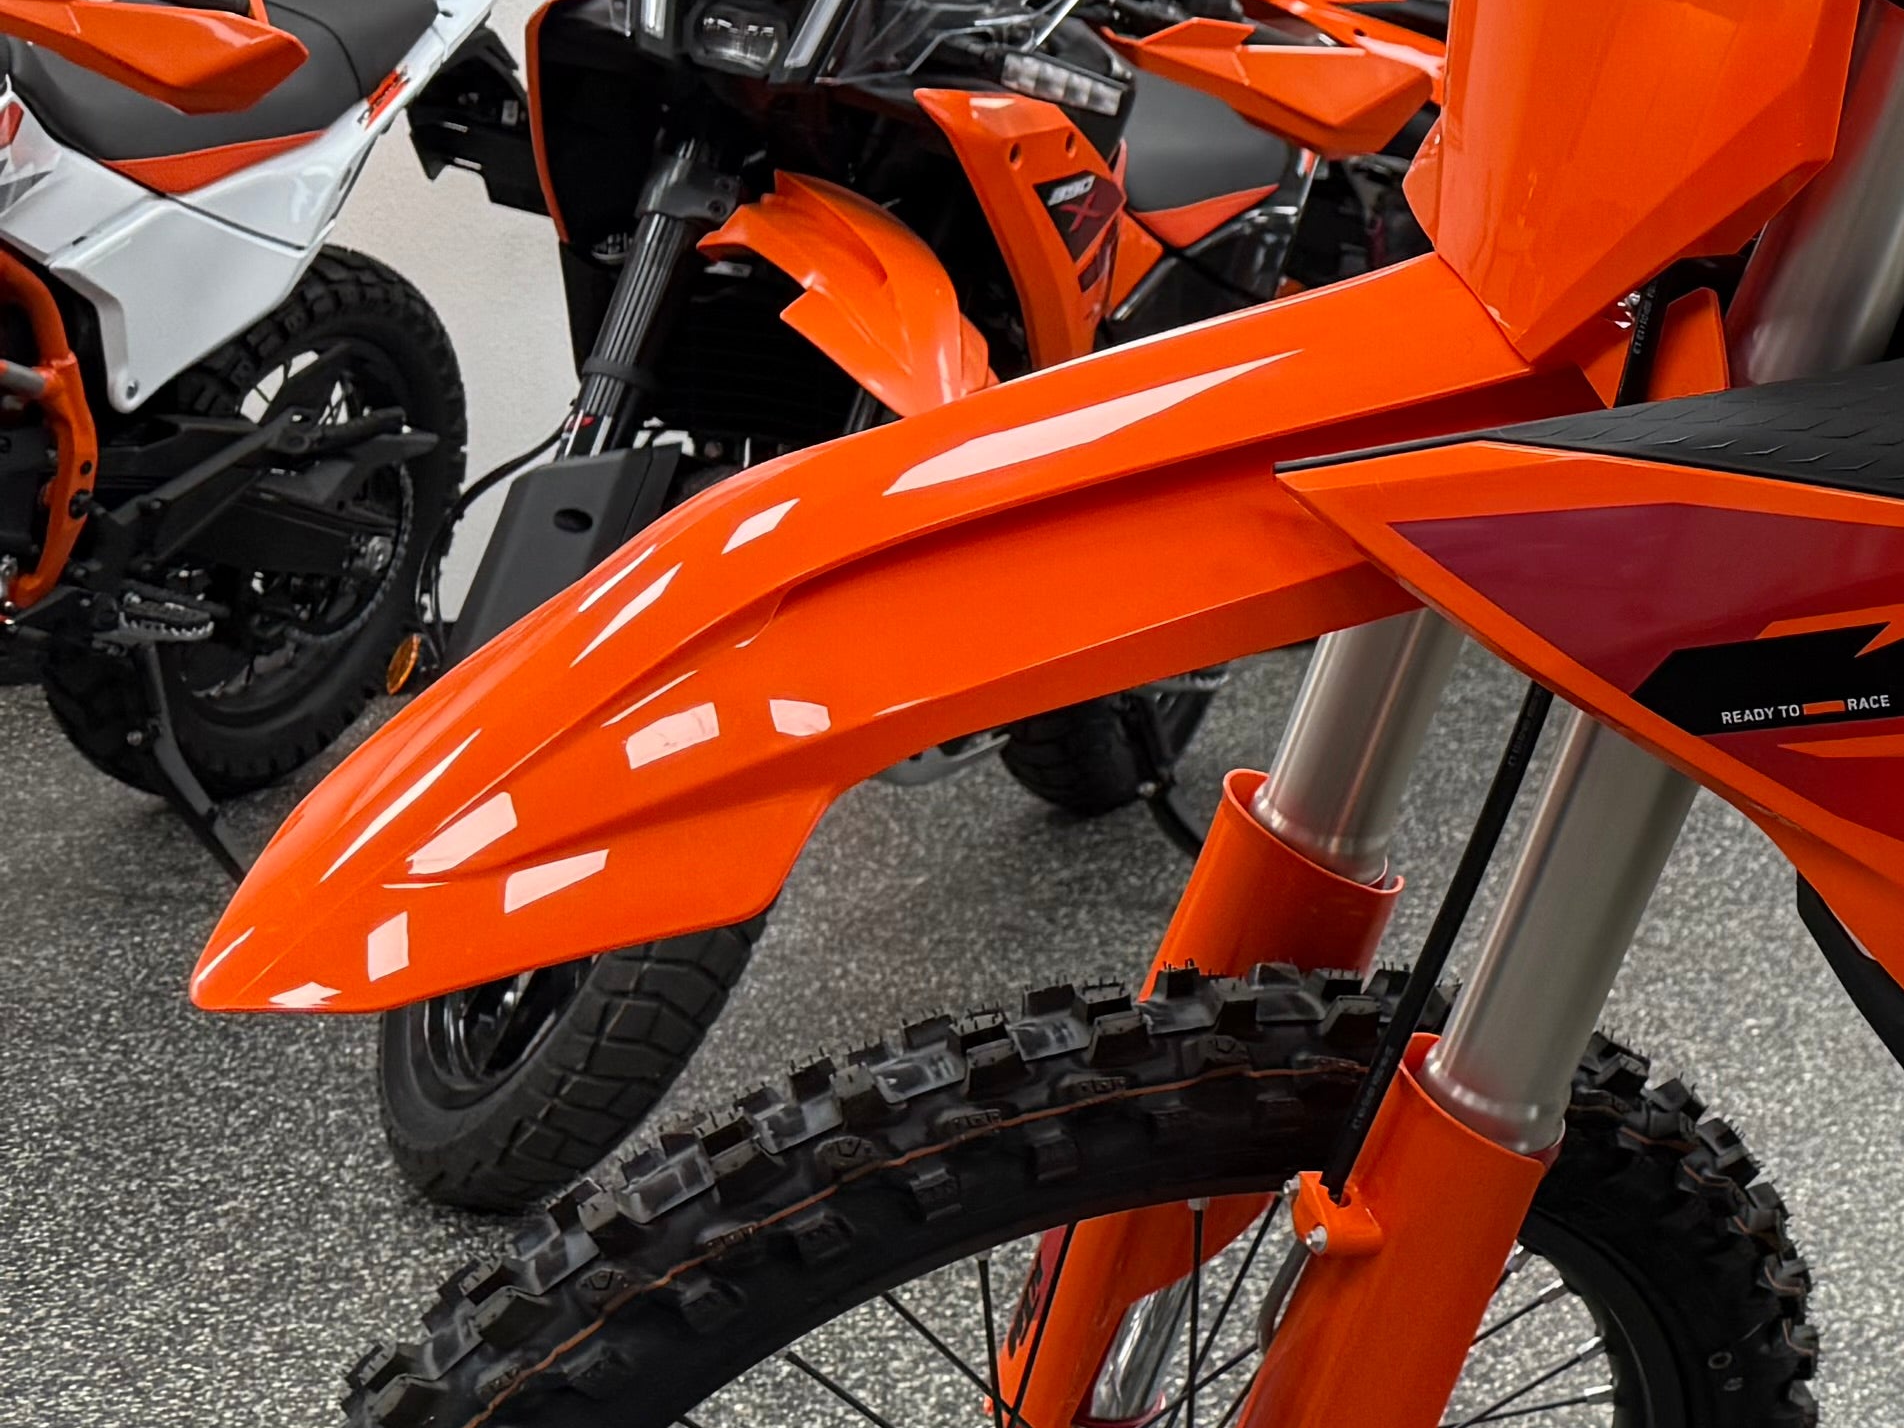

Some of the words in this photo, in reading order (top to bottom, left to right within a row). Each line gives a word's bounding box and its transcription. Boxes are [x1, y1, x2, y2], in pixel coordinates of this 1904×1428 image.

[1721, 706, 1775, 725] READY
[1777, 704, 1800, 719] TO
[1847, 694, 1891, 712] RACE
